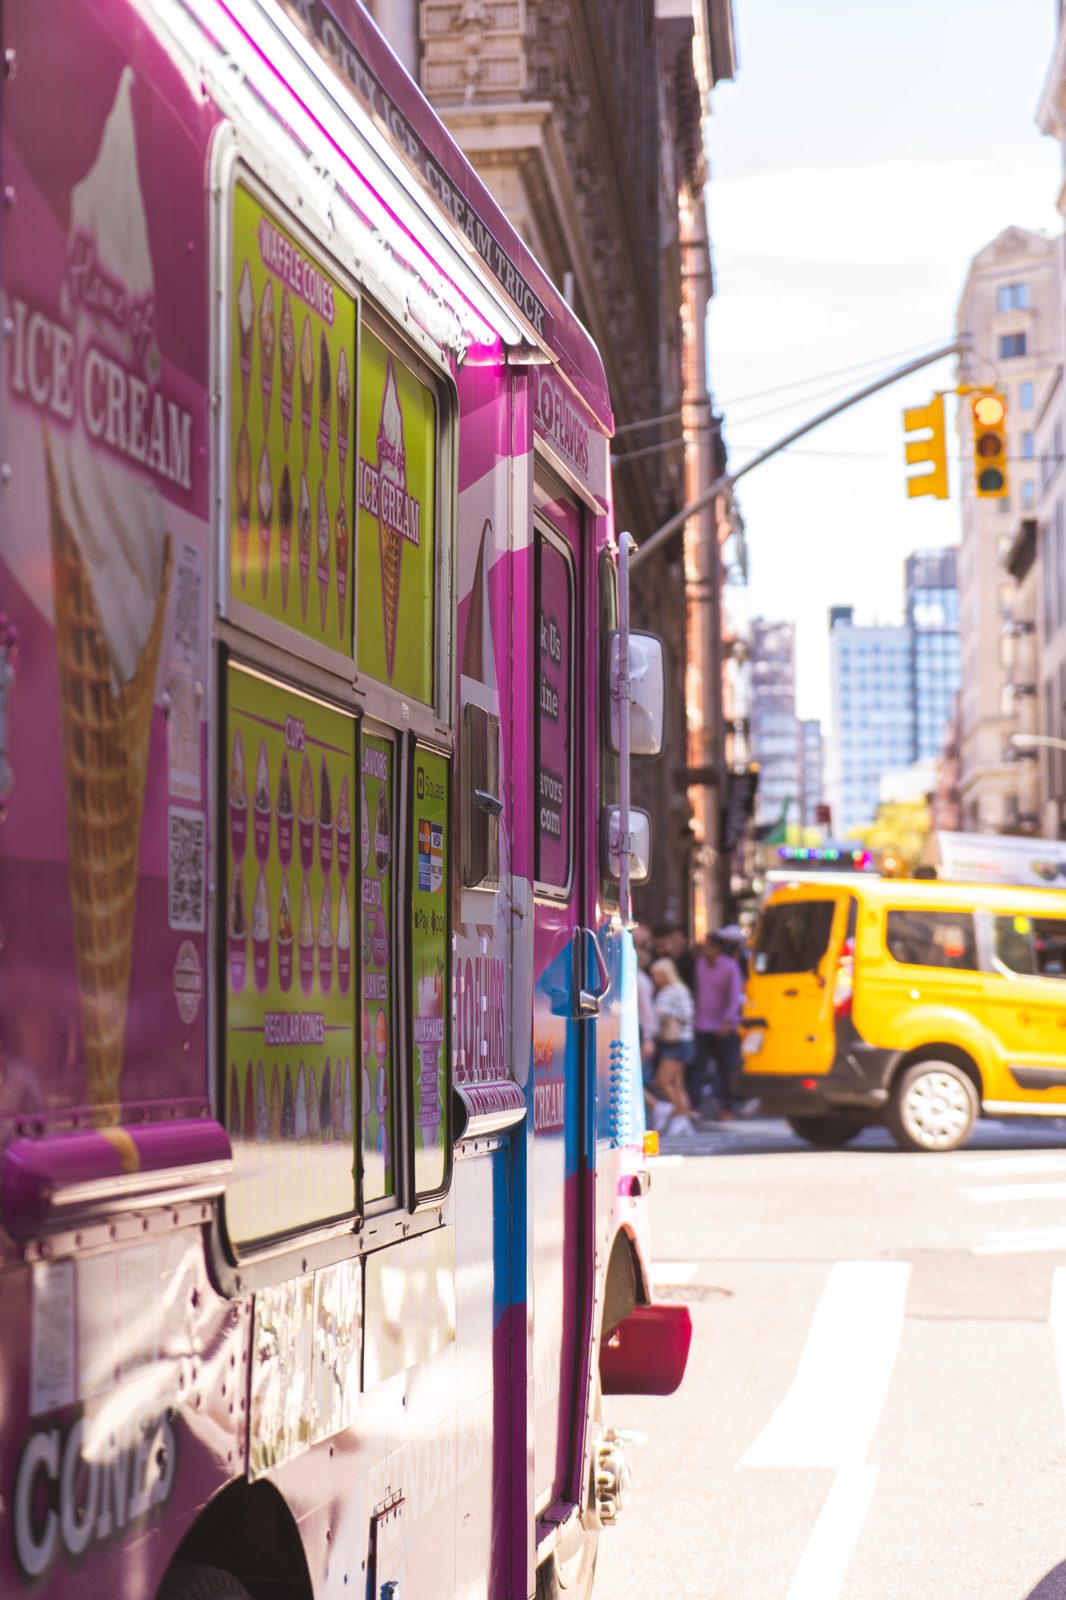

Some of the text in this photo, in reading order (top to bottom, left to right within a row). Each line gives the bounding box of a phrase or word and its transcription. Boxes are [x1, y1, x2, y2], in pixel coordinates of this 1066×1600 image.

[380, 94, 419, 163] ICE
[425, 160, 493, 264] CREAM
[495, 245, 545, 336] TRUCK
[260, 218, 333, 322] WAFFLE CONES
[13, 298, 192, 490] ICE CREAM
[359, 459, 420, 545] ICE CREAM
[549, 622, 561, 661] Us
[425, 775, 444, 801] Square
[541, 807, 560, 835] com
[534, 1083, 564, 1130] CREAM
